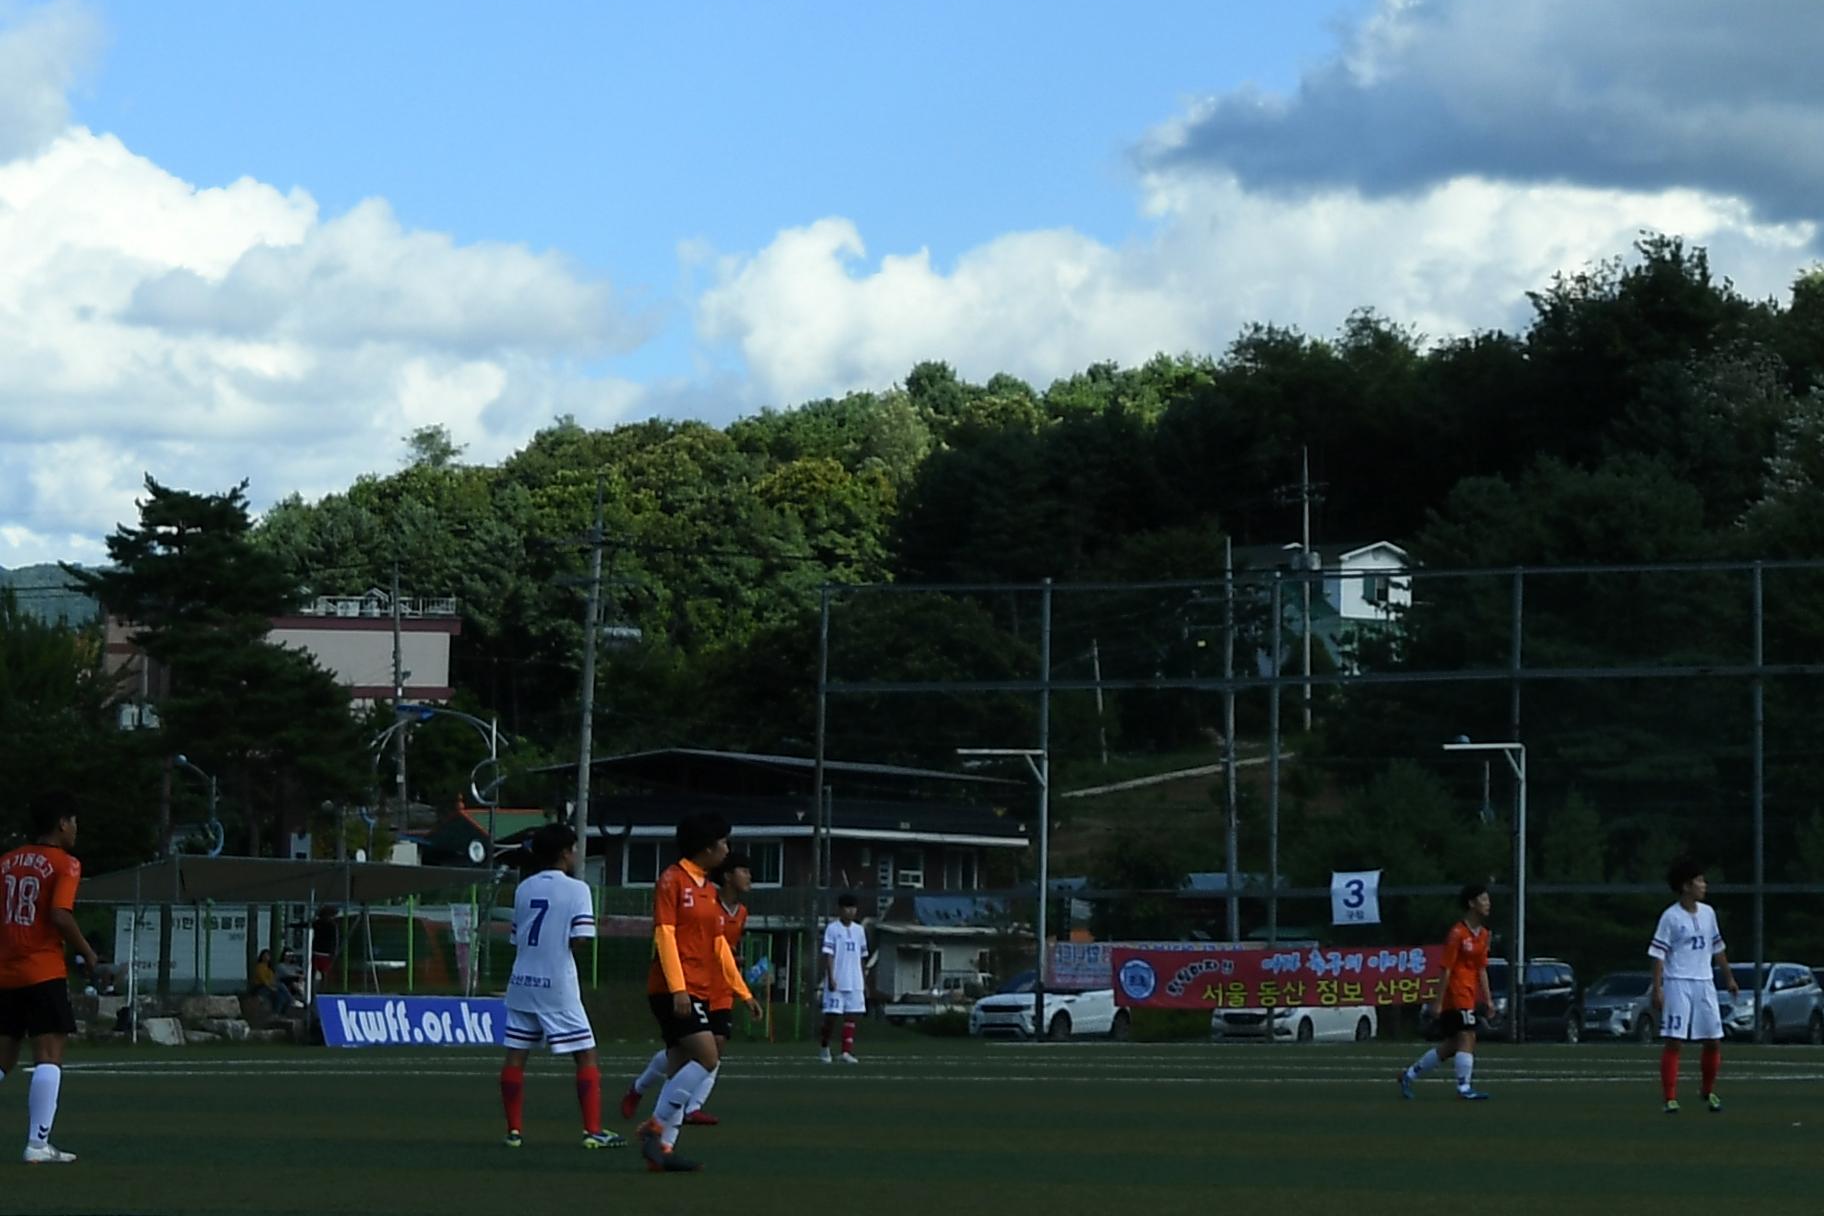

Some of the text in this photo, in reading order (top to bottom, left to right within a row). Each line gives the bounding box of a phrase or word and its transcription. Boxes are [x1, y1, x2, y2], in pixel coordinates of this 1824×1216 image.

[4, 874, 40, 926] 18
[683, 888, 694, 907] 5
[1343, 879, 1364, 908] 3
[528, 899, 549, 946] 7
[1691, 936, 1706, 950] 23
[1202, 981, 1248, 1008] 서울
[1258, 979, 1306, 1008] 동산
[1316, 979, 1364, 1006] 정보
[337, 999, 495, 1044] kwff.or.kr
[693, 1002, 709, 1024] 5
